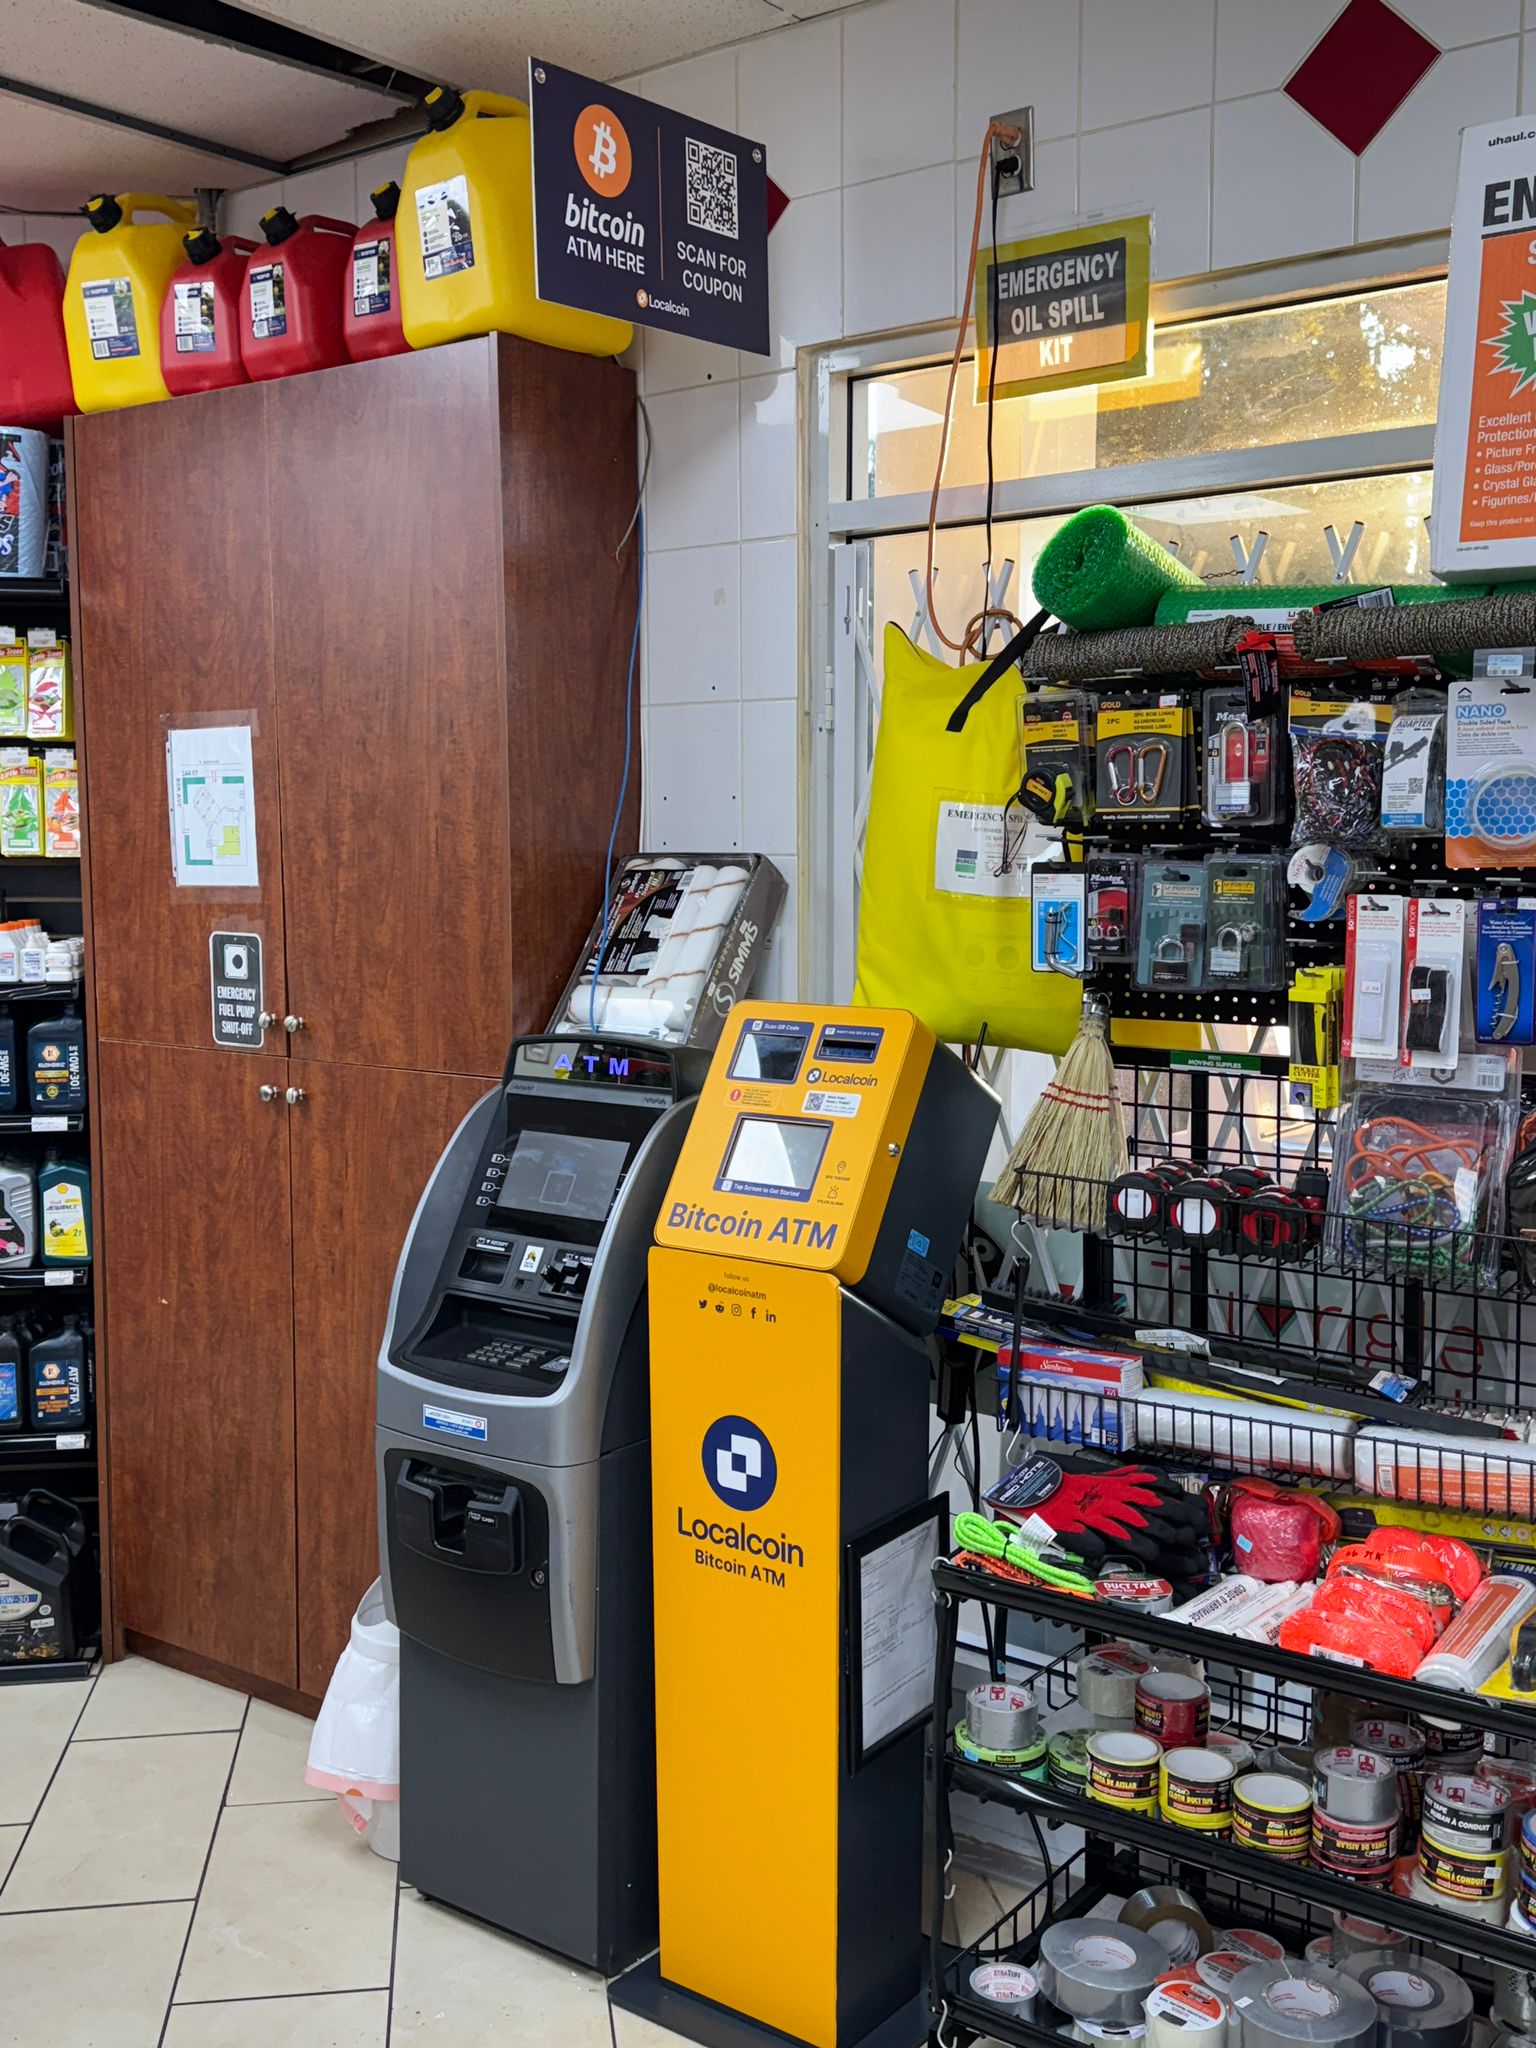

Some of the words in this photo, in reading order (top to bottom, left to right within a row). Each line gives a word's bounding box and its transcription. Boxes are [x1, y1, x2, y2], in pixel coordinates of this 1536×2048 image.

[565, 193, 645, 247] bitcoin
[566, 236, 601, 263] ATM
[606, 246, 645, 275] HERE
[677, 241, 716, 267] SCAN
[720, 253, 747, 278] FOR
[998, 250, 1119, 300] EMERGENCY
[682, 270, 742, 303] COUPON
[649, 294, 690, 317] Localcoin
[1011, 305, 1042, 336] OIL
[1048, 293, 1105, 329] SPILL
[1039, 336, 1073, 367] KIT
[1479, 411, 1531, 428] Excellent
[1486, 446, 1522, 459] Picture
[1483, 477, 1519, 493] Crystal
[1101, 701, 1121, 709] GOLD
[1456, 704, 1506, 718] NANO
[1396, 720, 1433, 728] ADAPTER
[729, 919, 758, 985] SIMMS
[217, 985, 256, 1001] EMERGENCY
[219, 1003, 234, 1017] FUEL
[236, 1004, 255, 1019] PUMP
[221, 1020, 253, 1036] SHUT-OFF
[1187, 1059, 1215, 1067] MOVING
[822, 1071, 878, 1087] Localcoin
[667, 1202, 762, 1239] Bitcoin
[768, 1216, 839, 1250] ATM
[708, 1282, 766, 1301] @localcoinatm
[1040, 1360, 1073, 1374] Sunbeam
[678, 1506, 804, 1568] Localcoin
[695, 1549, 746, 1577] Bitcoin
[750, 1565, 785, 1588] ATM
[1433, 1804, 1448, 1814] TAPE
[1430, 1809, 1450, 1823] RUBAN
[1458, 1821, 1491, 1831] CONDUIT
[1457, 1875, 1487, 1886] CONDUIT
